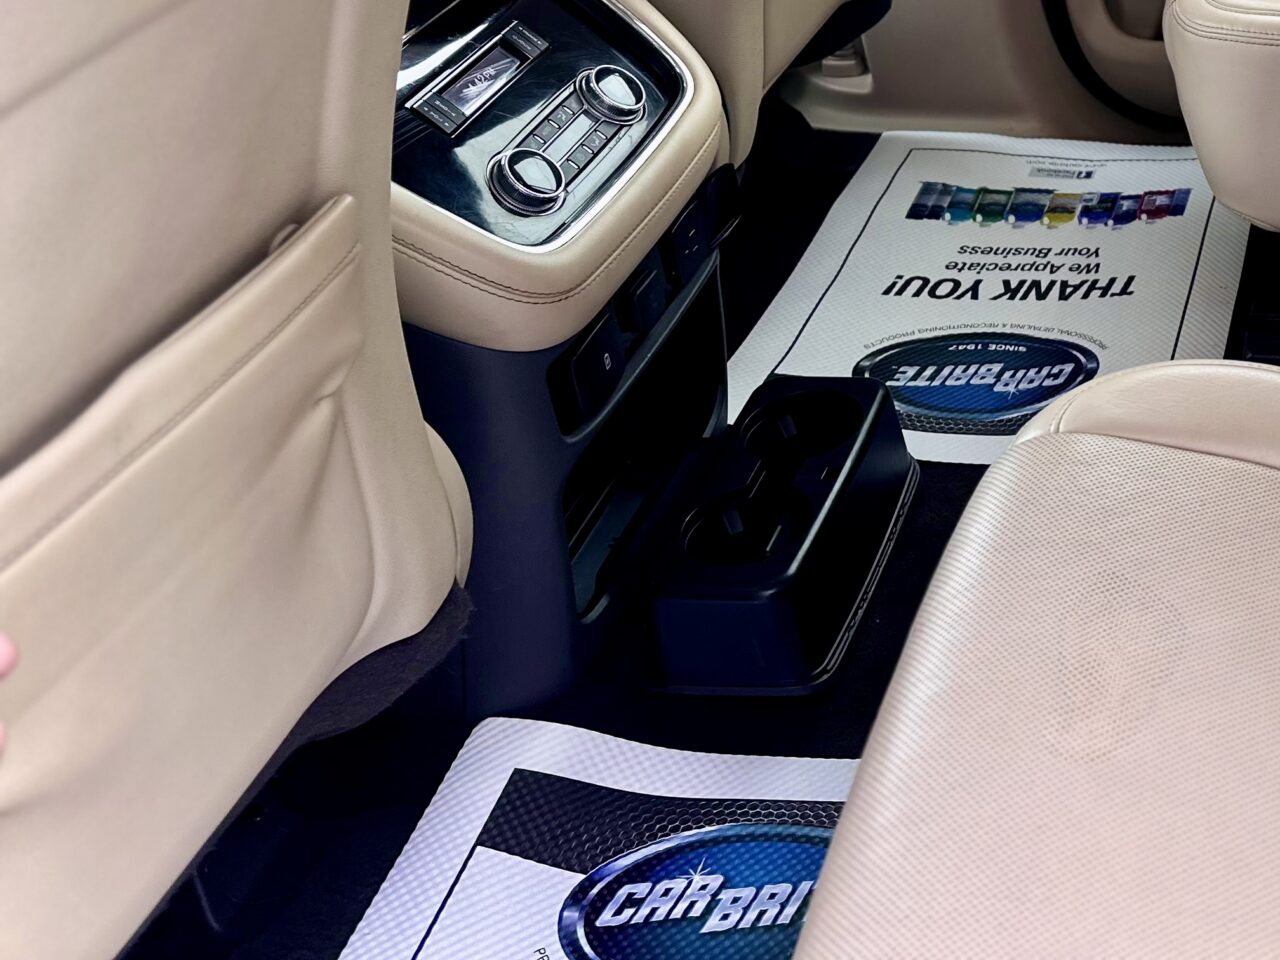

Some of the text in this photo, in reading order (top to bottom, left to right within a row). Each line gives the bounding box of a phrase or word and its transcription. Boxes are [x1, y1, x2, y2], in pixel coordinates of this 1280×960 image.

[956, 244, 1101, 258] Your Business
[944, 260, 1100, 275] We Appreciate
[880, 274, 1136, 301] THANK YOU!
[917, 322, 999, 334] RECONDITIONING
[1009, 321, 1055, 333] DETAILING
[863, 328, 914, 349] PRODUCTS
[947, 342, 1027, 351] SINCE 1947
[595, 874, 816, 934] CARBRI
